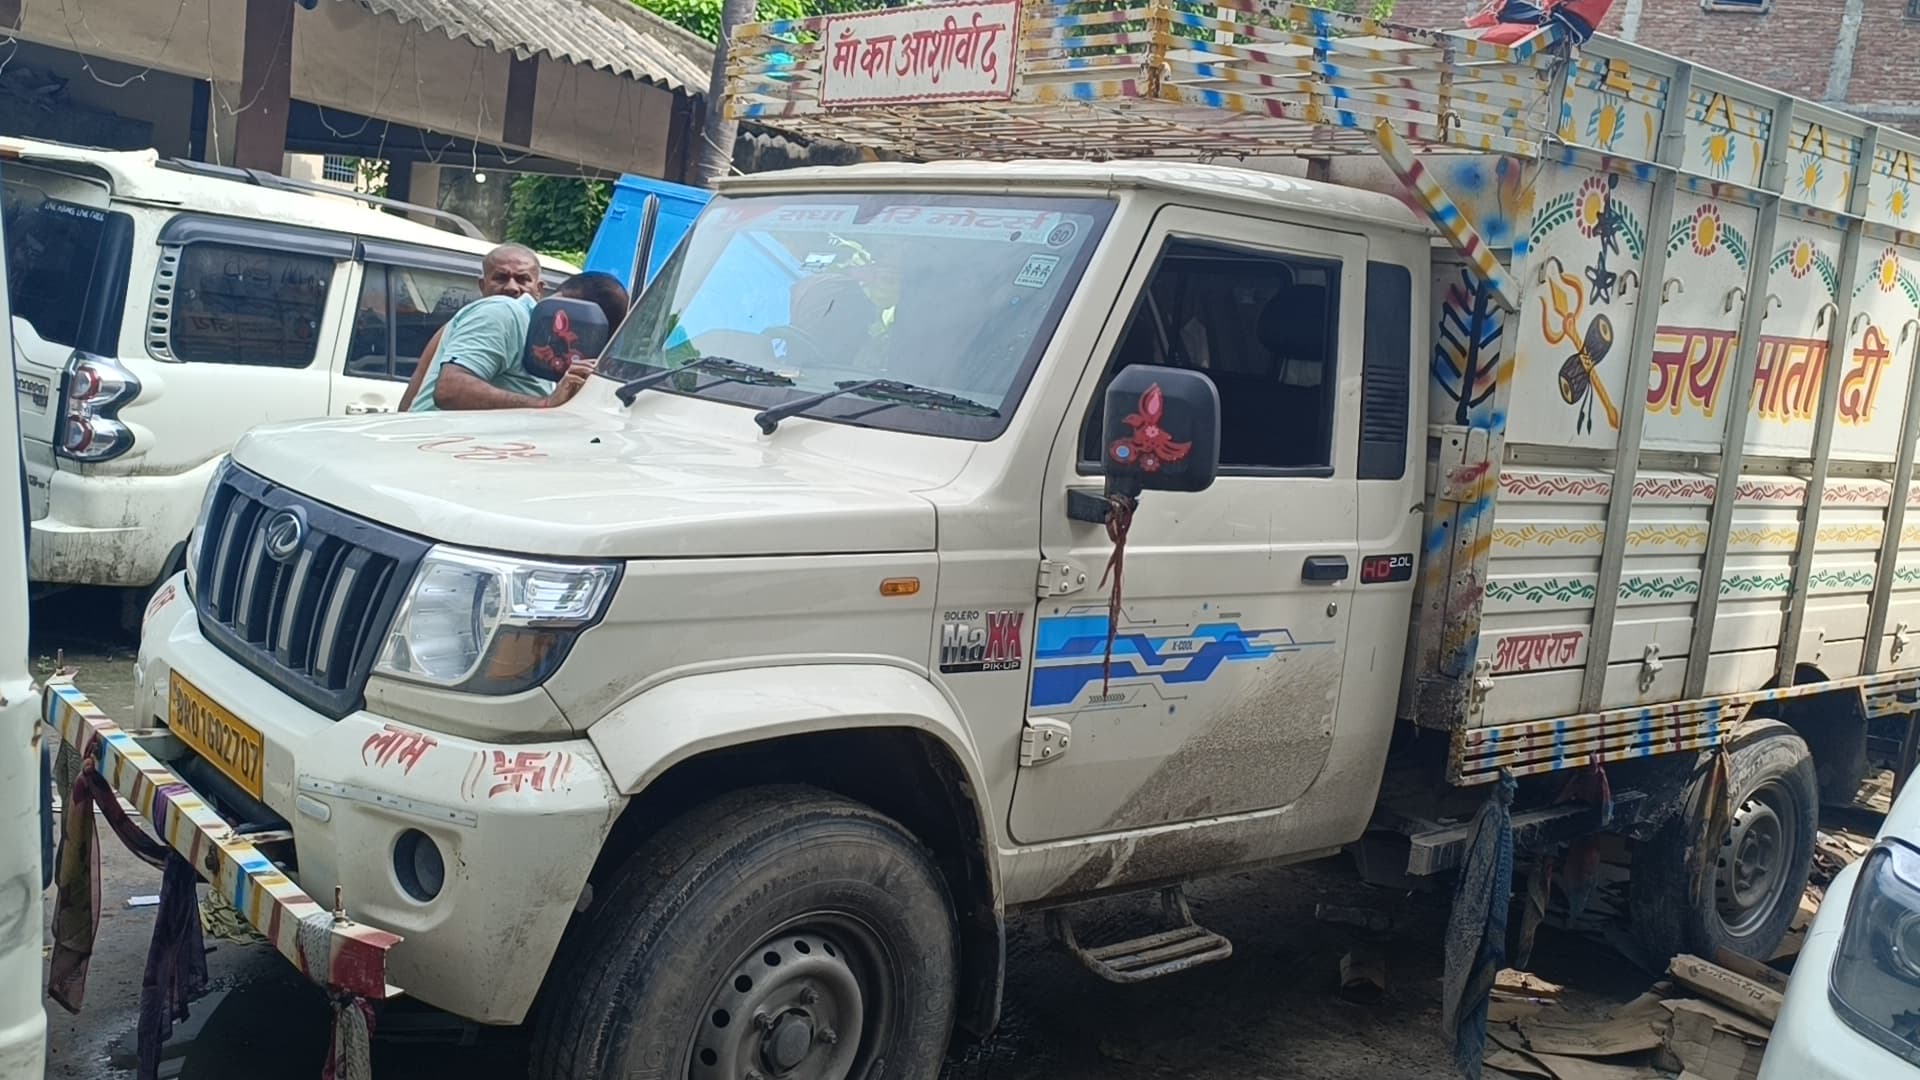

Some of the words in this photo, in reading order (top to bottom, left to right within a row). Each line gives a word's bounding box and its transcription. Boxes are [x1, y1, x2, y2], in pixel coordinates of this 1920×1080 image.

[861, 34, 897, 80] का
[895, 11, 1006, 85] आशीर्वाद
[1645, 324, 1741, 417] जय
[1838, 324, 1891, 424] दी
[1363, 560, 1391, 578] HD
[944, 610, 980, 621] BOLERO
[982, 660, 1020, 671] PIK-UP
[361, 723, 438, 777] लाभ
